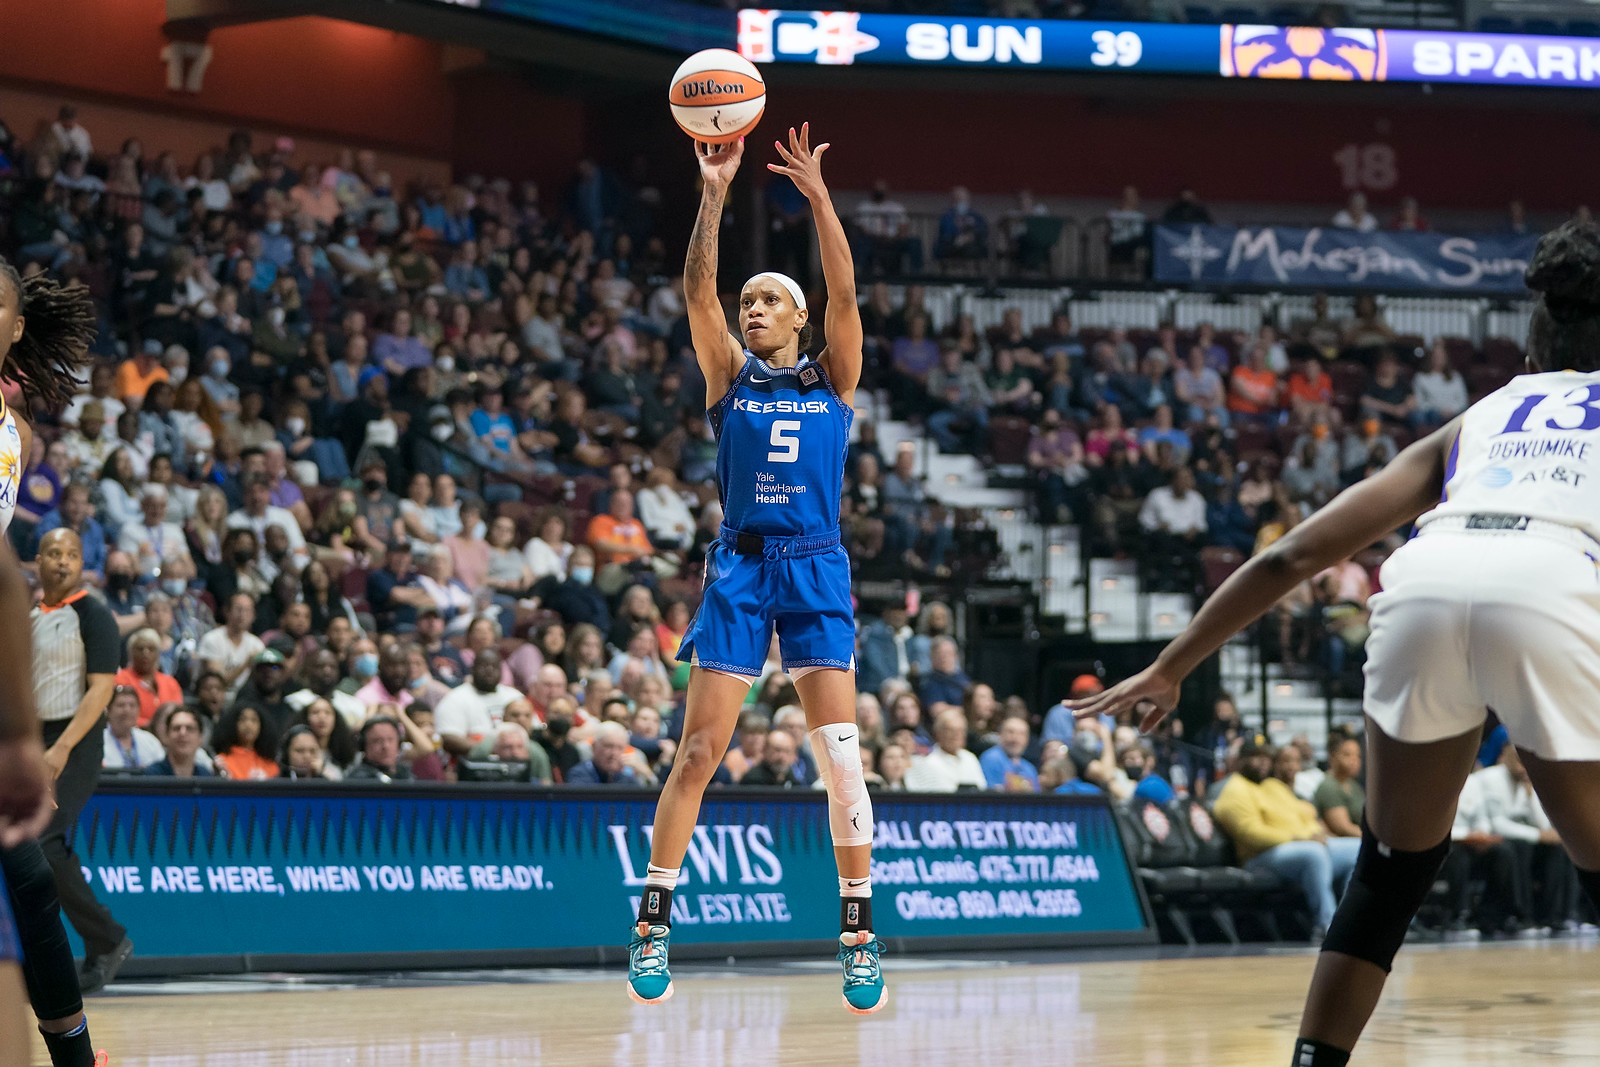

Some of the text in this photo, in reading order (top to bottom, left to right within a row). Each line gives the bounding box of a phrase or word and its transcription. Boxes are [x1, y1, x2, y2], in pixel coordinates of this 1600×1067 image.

[905, 22, 1142, 67] SUN 39
[160, 42, 213, 91] 17
[682, 79, 745, 99] Wilson
[1333, 143, 1398, 189] 18
[1226, 228, 1527, 287] Mohegan Sun
[733, 397, 830, 414] KEESUSK
[1490, 384, 1600, 438] 13
[767, 420, 801, 463] 5
[756, 472, 775, 482] Yale
[756, 483, 807, 494] NewHaven
[1519, 466, 1586, 487] AT&T
[756, 494, 789, 504] Health
[919, 820, 957, 849] OR
[953, 821, 1010, 850] TEXT
[1008, 821, 1078, 850] TODAY
[98, 866, 144, 893] WE
[151, 866, 204, 893] ARE
[206, 865, 285, 897] HERE,
[285, 865, 361, 892] WHEN
[362, 865, 415, 892] YOU
[420, 865, 468, 892] ARE
[469, 865, 554, 892] READY.
[916, 855, 979, 884] Lewis
[698, 892, 792, 924] ESTATE
